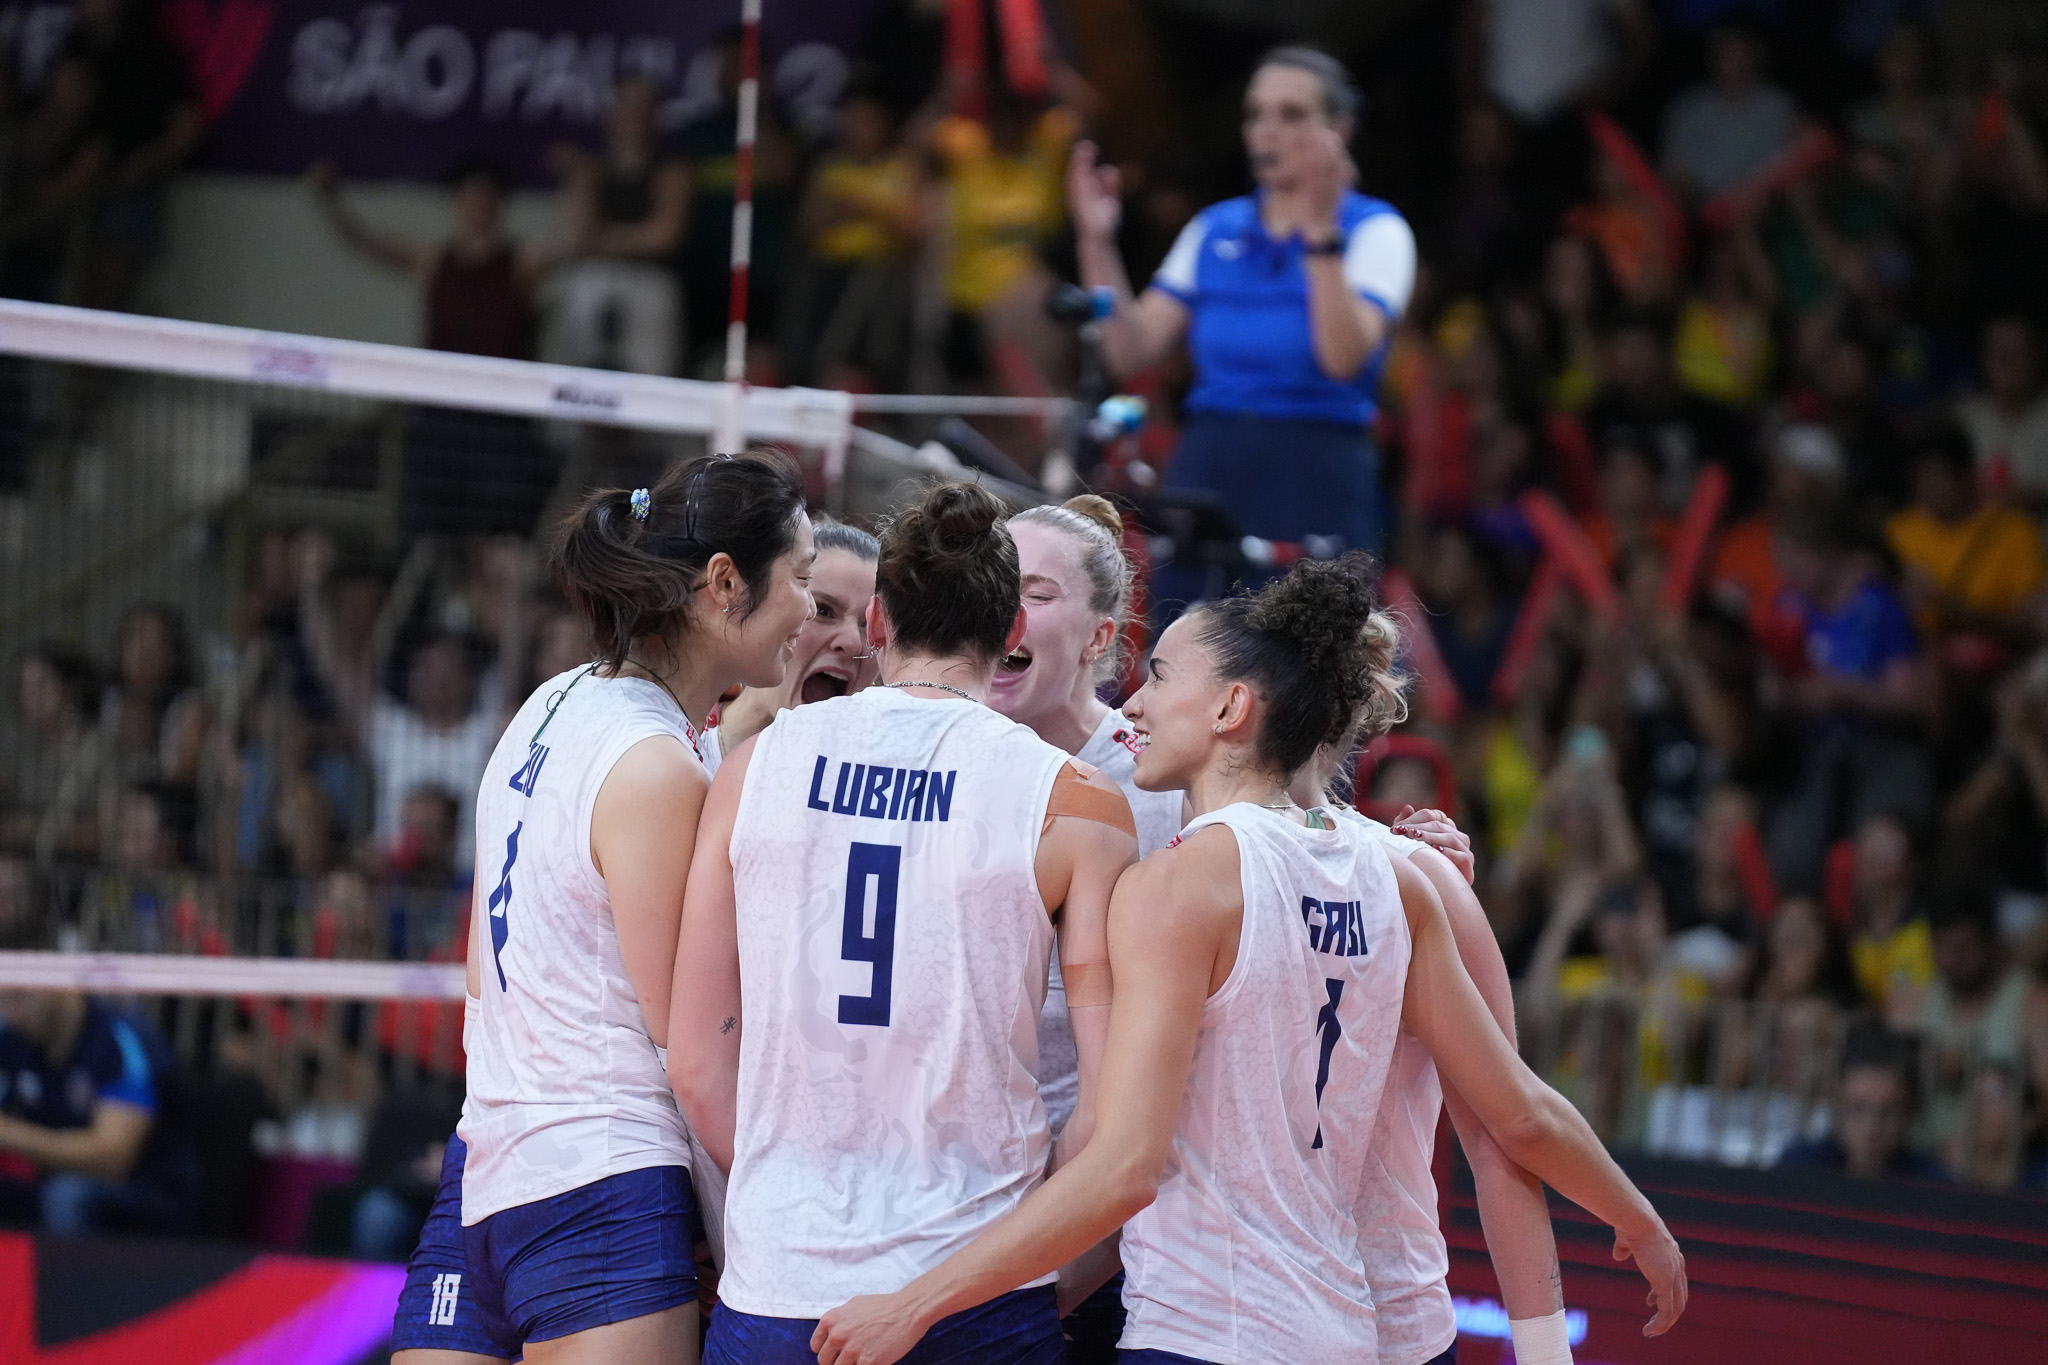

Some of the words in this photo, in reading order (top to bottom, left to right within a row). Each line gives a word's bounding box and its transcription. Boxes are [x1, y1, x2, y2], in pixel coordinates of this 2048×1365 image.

[288, 3, 474, 120] SÃO
[807, 755, 957, 822] LUBIAN
[838, 841, 902, 1028] 9
[1301, 895, 1368, 957] GABI
[1311, 977, 1345, 1150] 1
[428, 1273, 462, 1326] 18
